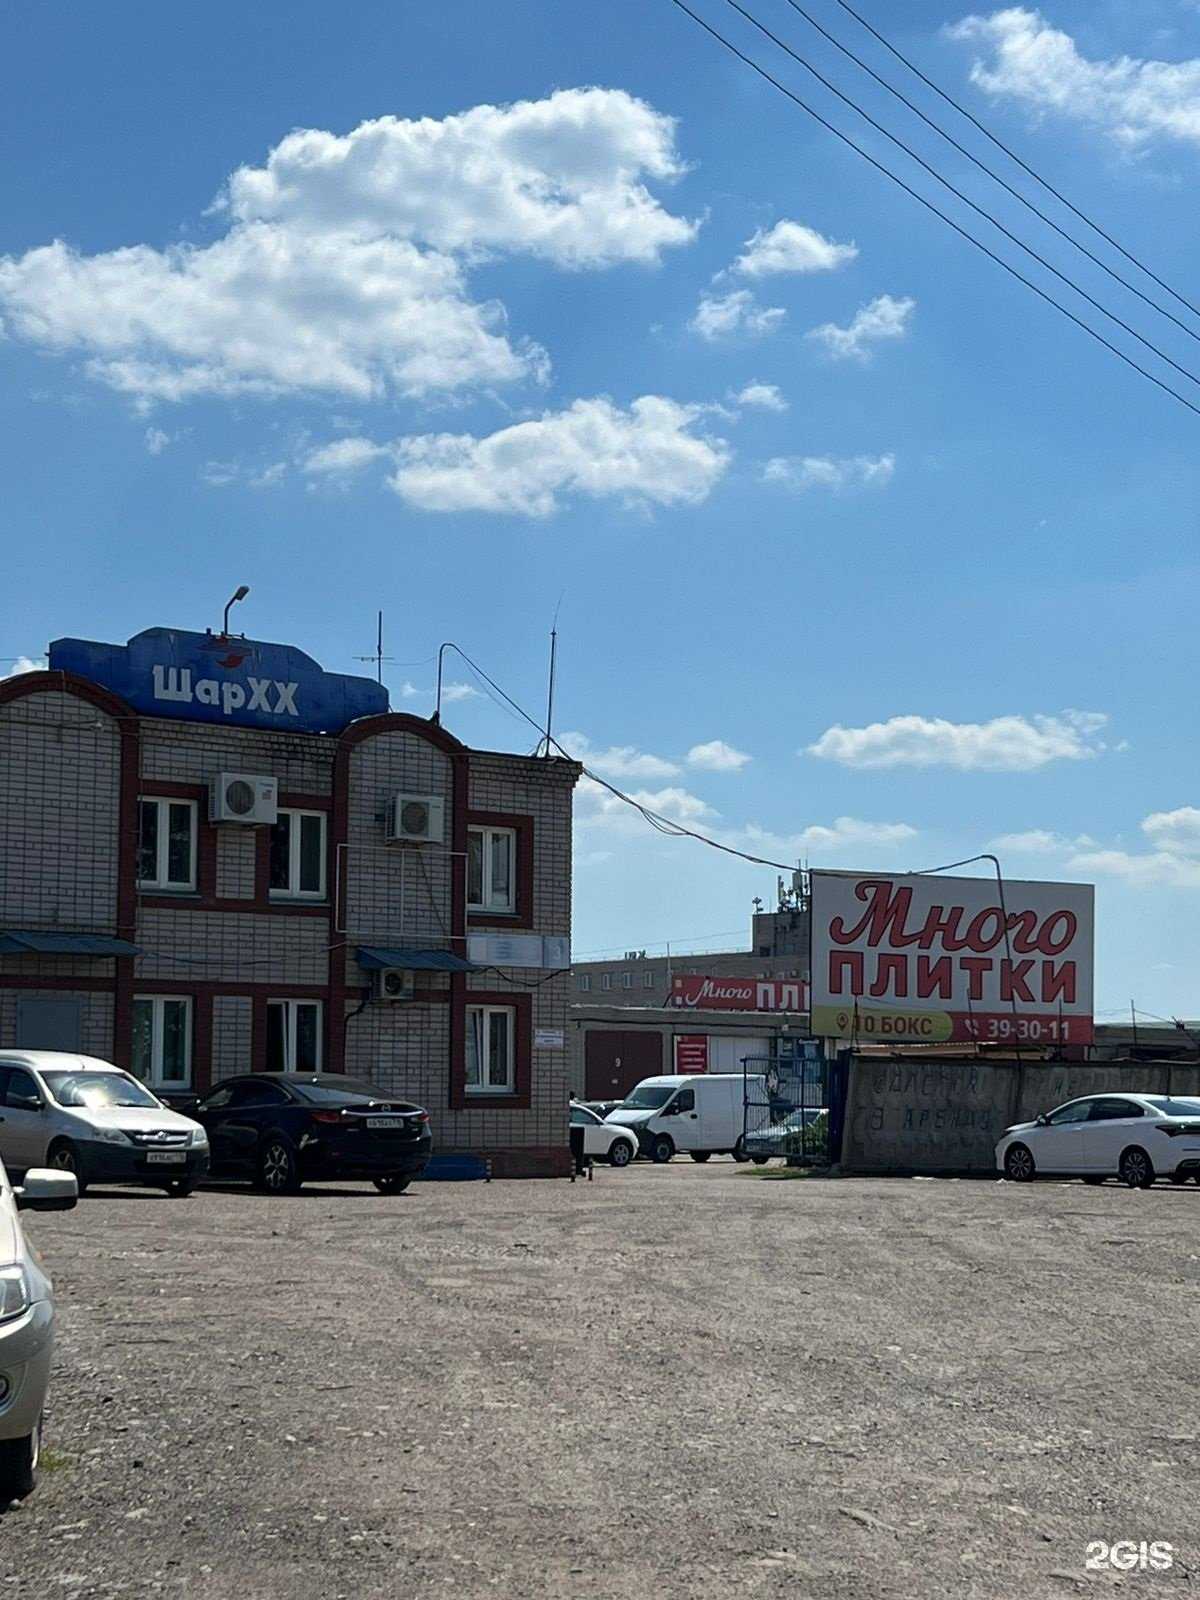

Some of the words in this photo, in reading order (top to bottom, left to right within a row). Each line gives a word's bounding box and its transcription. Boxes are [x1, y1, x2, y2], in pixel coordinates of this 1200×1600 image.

[829, 880, 1077, 956] Много
[829, 950, 1077, 1003] ПЛИТКИ
[685, 979, 752, 1006] Много
[756, 983, 810, 1010] ПЛ
[881, 1016, 932, 1036] БОКС
[988, 1019, 1070, 1040] 39-30-11
